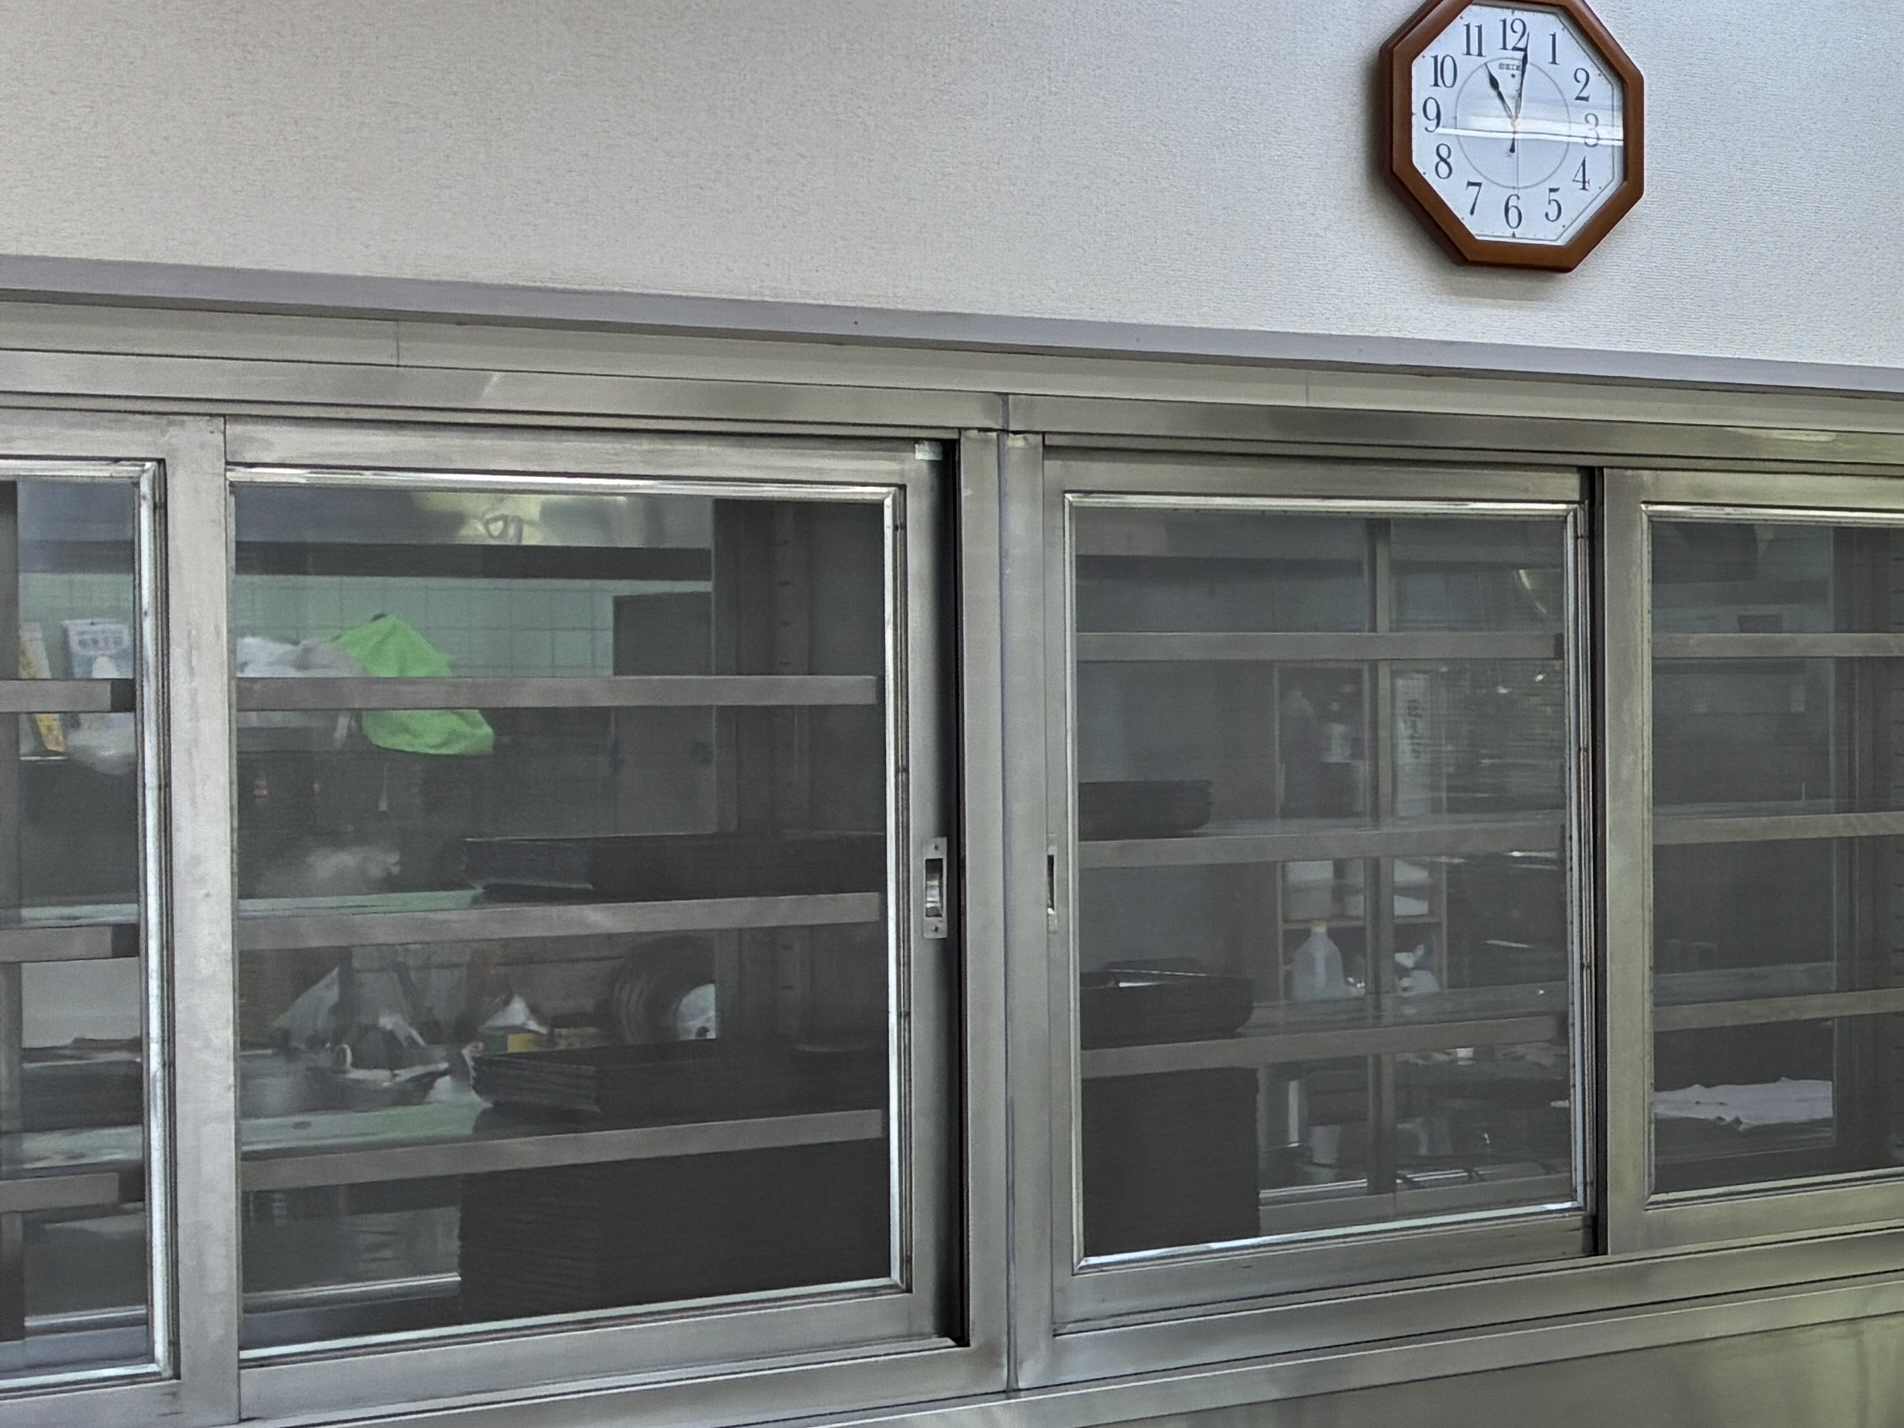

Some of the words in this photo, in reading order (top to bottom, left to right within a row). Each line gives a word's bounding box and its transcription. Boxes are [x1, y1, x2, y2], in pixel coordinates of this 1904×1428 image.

[1463, 23, 1486, 57] 11
[1499, 18, 1527, 52] 12
[1549, 32, 1559, 65] 1
[1430, 54, 1458, 88] 10
[1574, 68, 1590, 102] 2
[1422, 97, 1442, 133] 9
[1584, 113, 1600, 147] 3
[1435, 143, 1453, 179] 8
[1572, 155, 1590, 191] 4
[1466, 181, 1482, 216] 7
[1504, 194, 1522, 229] 6
[1545, 187, 1562, 222] 5
